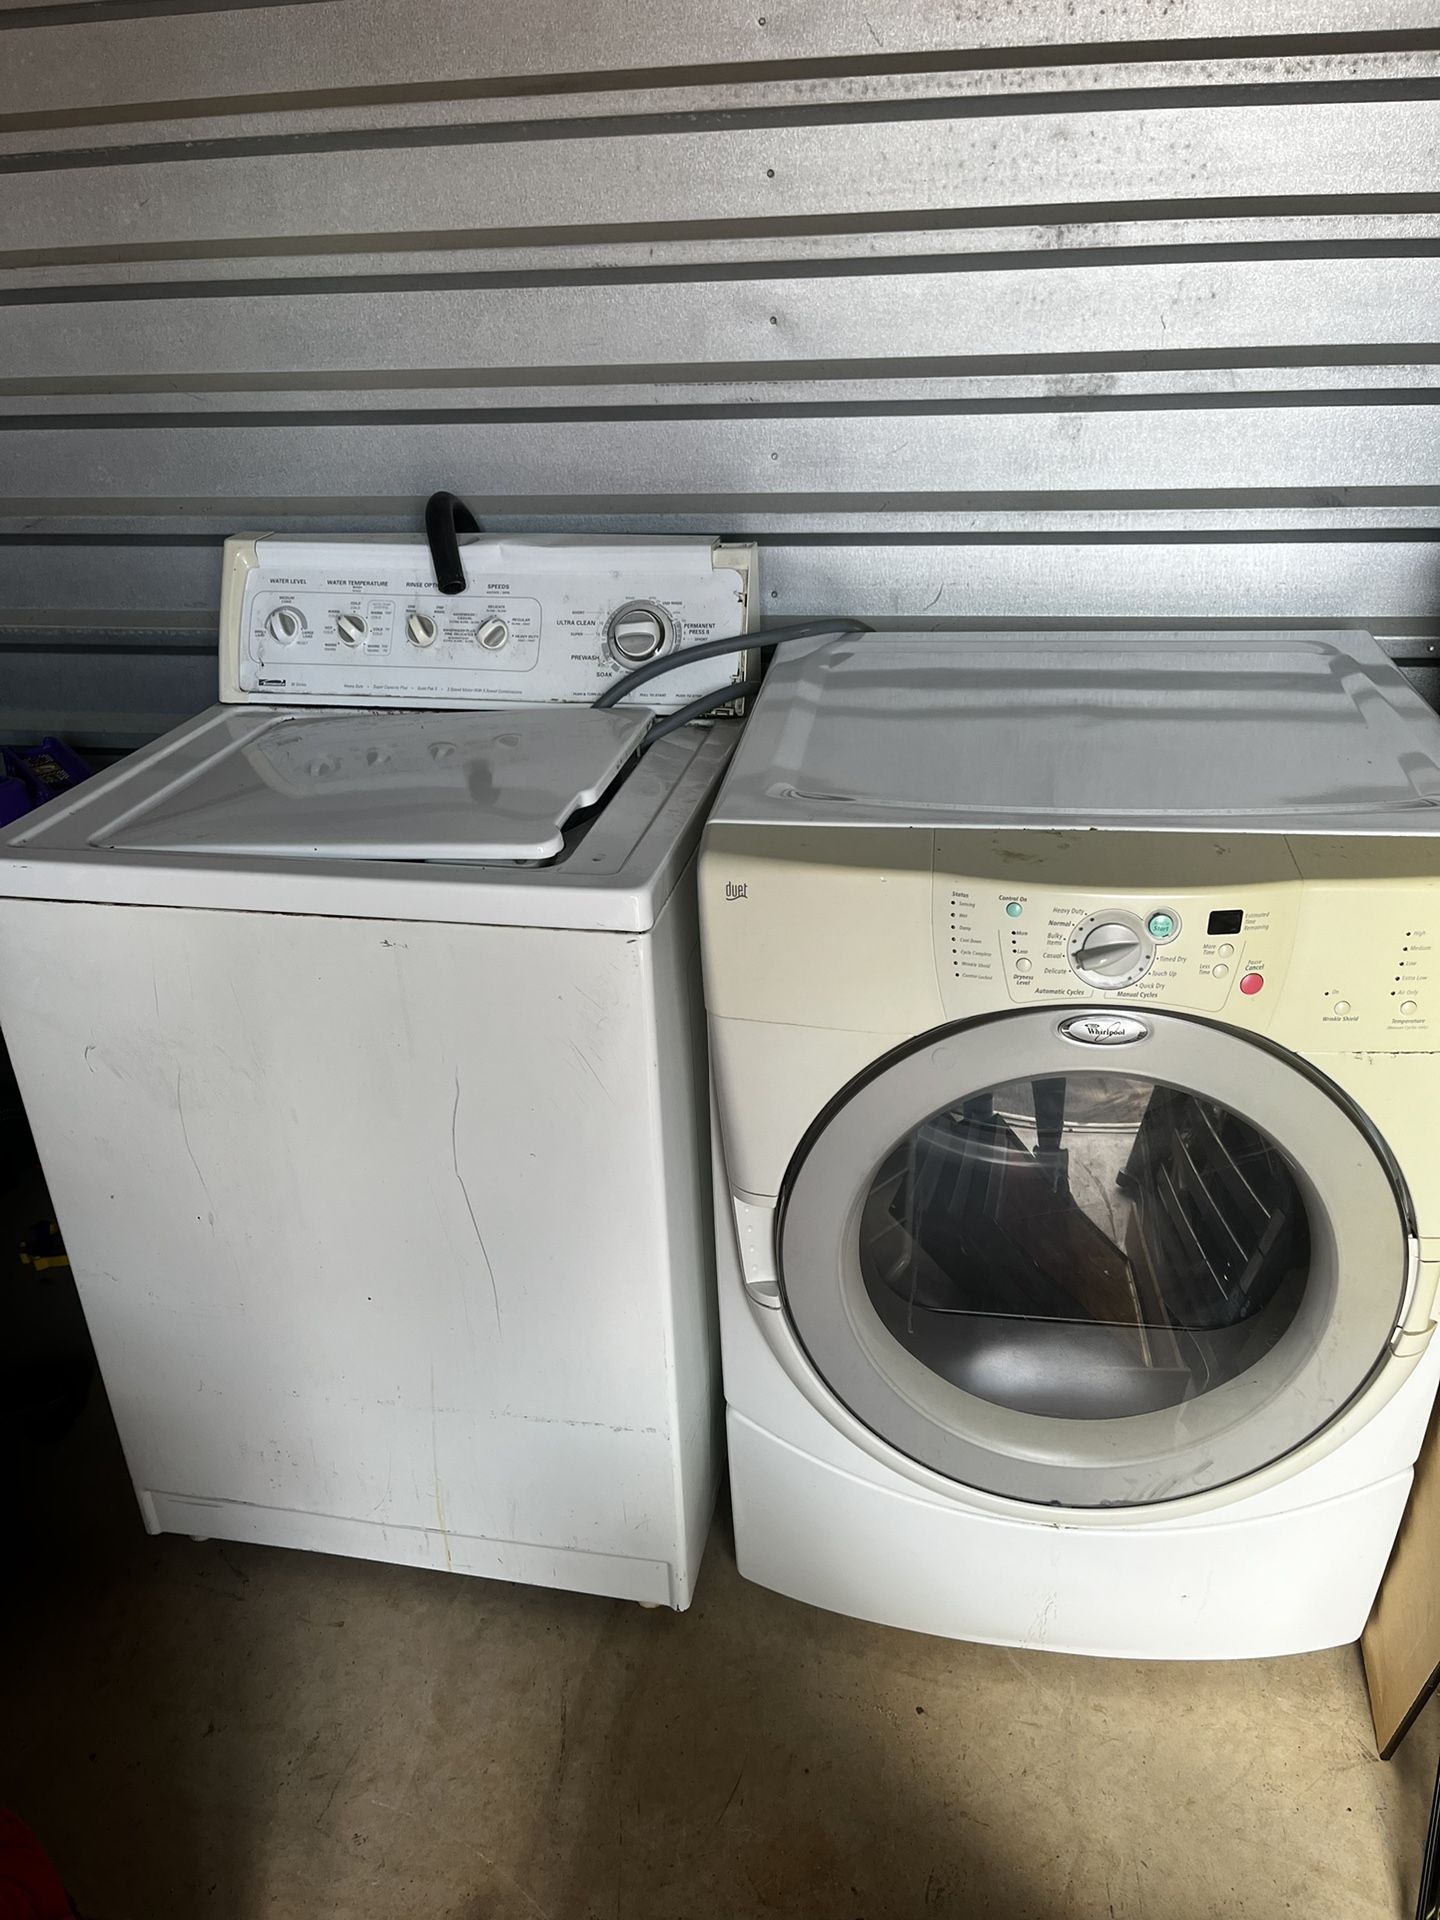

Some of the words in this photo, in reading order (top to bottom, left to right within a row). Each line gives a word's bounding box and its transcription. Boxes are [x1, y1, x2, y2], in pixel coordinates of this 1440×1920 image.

[726, 881, 748, 900] duet
[1053, 907, 1071, 916] Heavy
[1071, 908, 1085, 916] Duty
[1047, 933, 1063, 941] Bulky
[1178, 956, 1187, 964] Dry
[1066, 988, 1085, 996] Cycles
